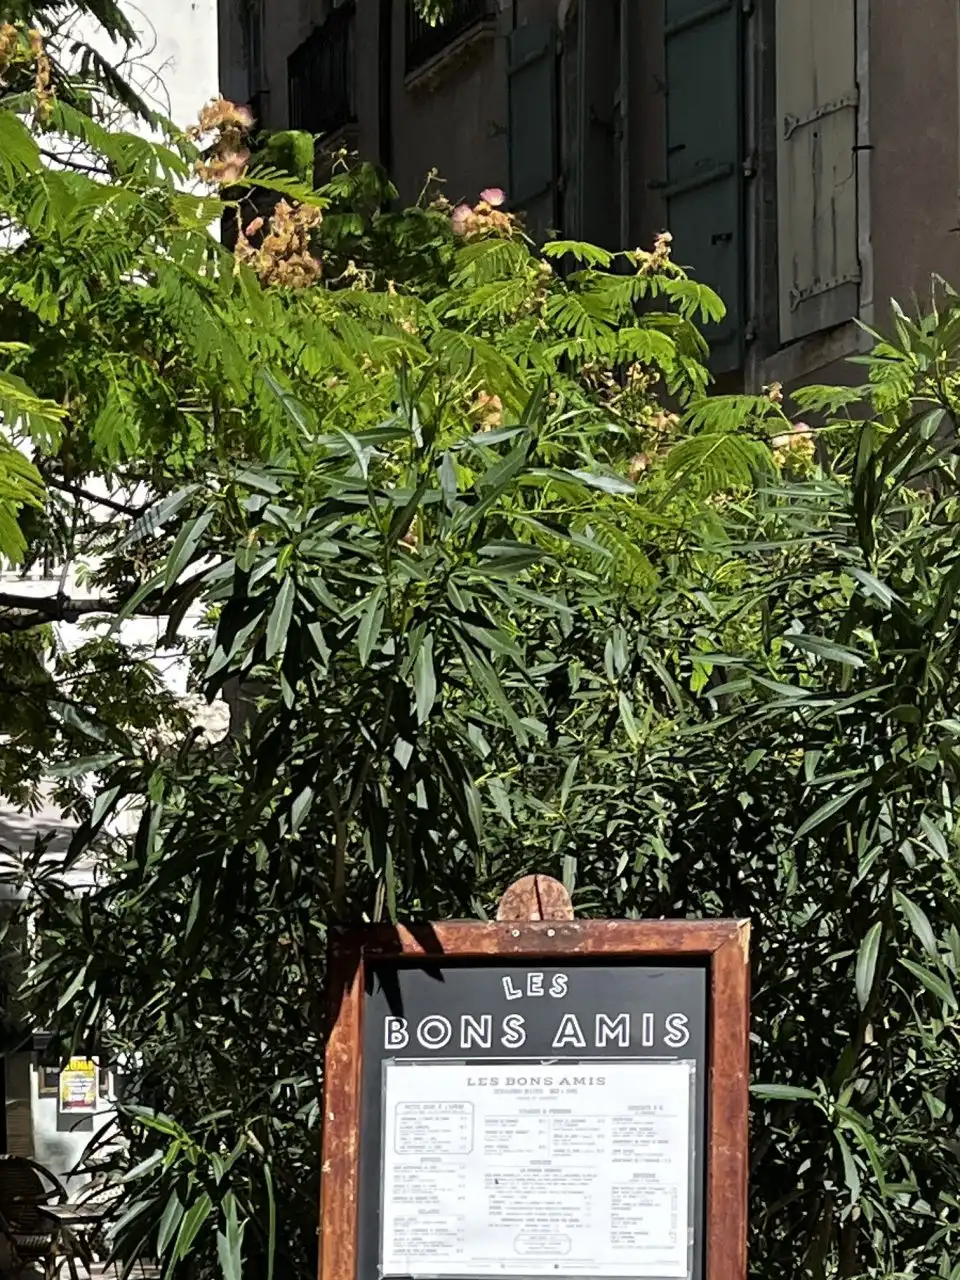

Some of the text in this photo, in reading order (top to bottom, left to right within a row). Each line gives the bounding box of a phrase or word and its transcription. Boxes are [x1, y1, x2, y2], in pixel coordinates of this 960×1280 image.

[502, 973, 568, 1000] LES
[384, 1012, 690, 1050] BONS AMIS
[467, 1076, 606, 1087] LES BONS AMIS
